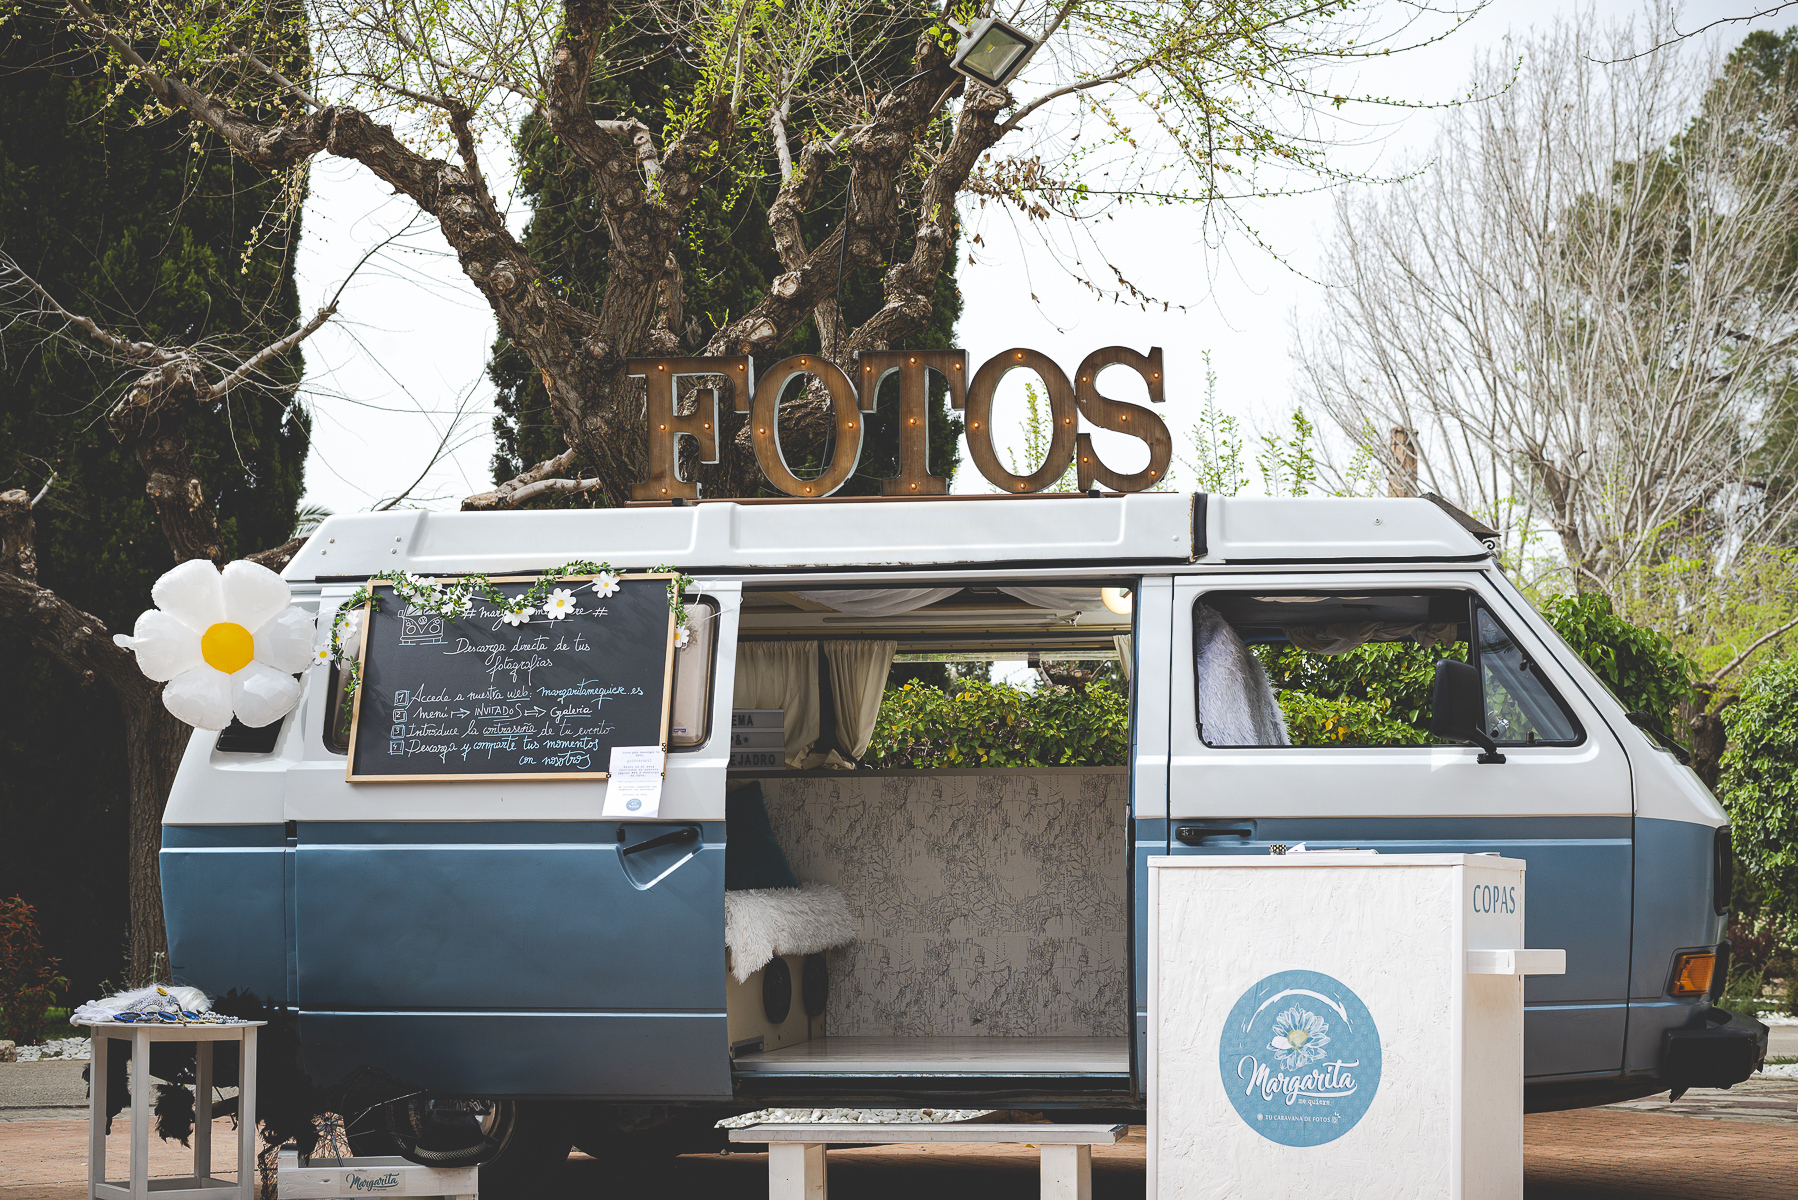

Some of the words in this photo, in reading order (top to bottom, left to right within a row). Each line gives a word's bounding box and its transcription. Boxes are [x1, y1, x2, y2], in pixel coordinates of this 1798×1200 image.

[626, 346, 1172, 498] FOTOS
[443, 637, 506, 665] Descarga
[510, 635, 550, 652] directa
[554, 636, 570, 651] de
[574, 633, 590, 651] tus
[405, 683, 452, 709] Accede
[467, 685, 504, 701] nuestra
[406, 723, 460, 737] Introduce
[461, 720, 479, 738] la
[482, 722, 537, 735] contraseña
[537, 721, 555, 737] de
[560, 719, 574, 736] tu
[573, 720, 615, 737] evento
[405, 739, 458, 764] Descarga
[460, 743, 471, 761] y
[473, 735, 517, 759] comparte
[523, 735, 540, 751] tus
[543, 736, 599, 751] momentos
[518, 756, 537, 765] con
[541, 750, 591, 769] nosotros
[1473, 884, 1516, 914] COPAS
[1237, 1055, 1360, 1106] Margarita
[345, 1172, 400, 1192] Margarita
